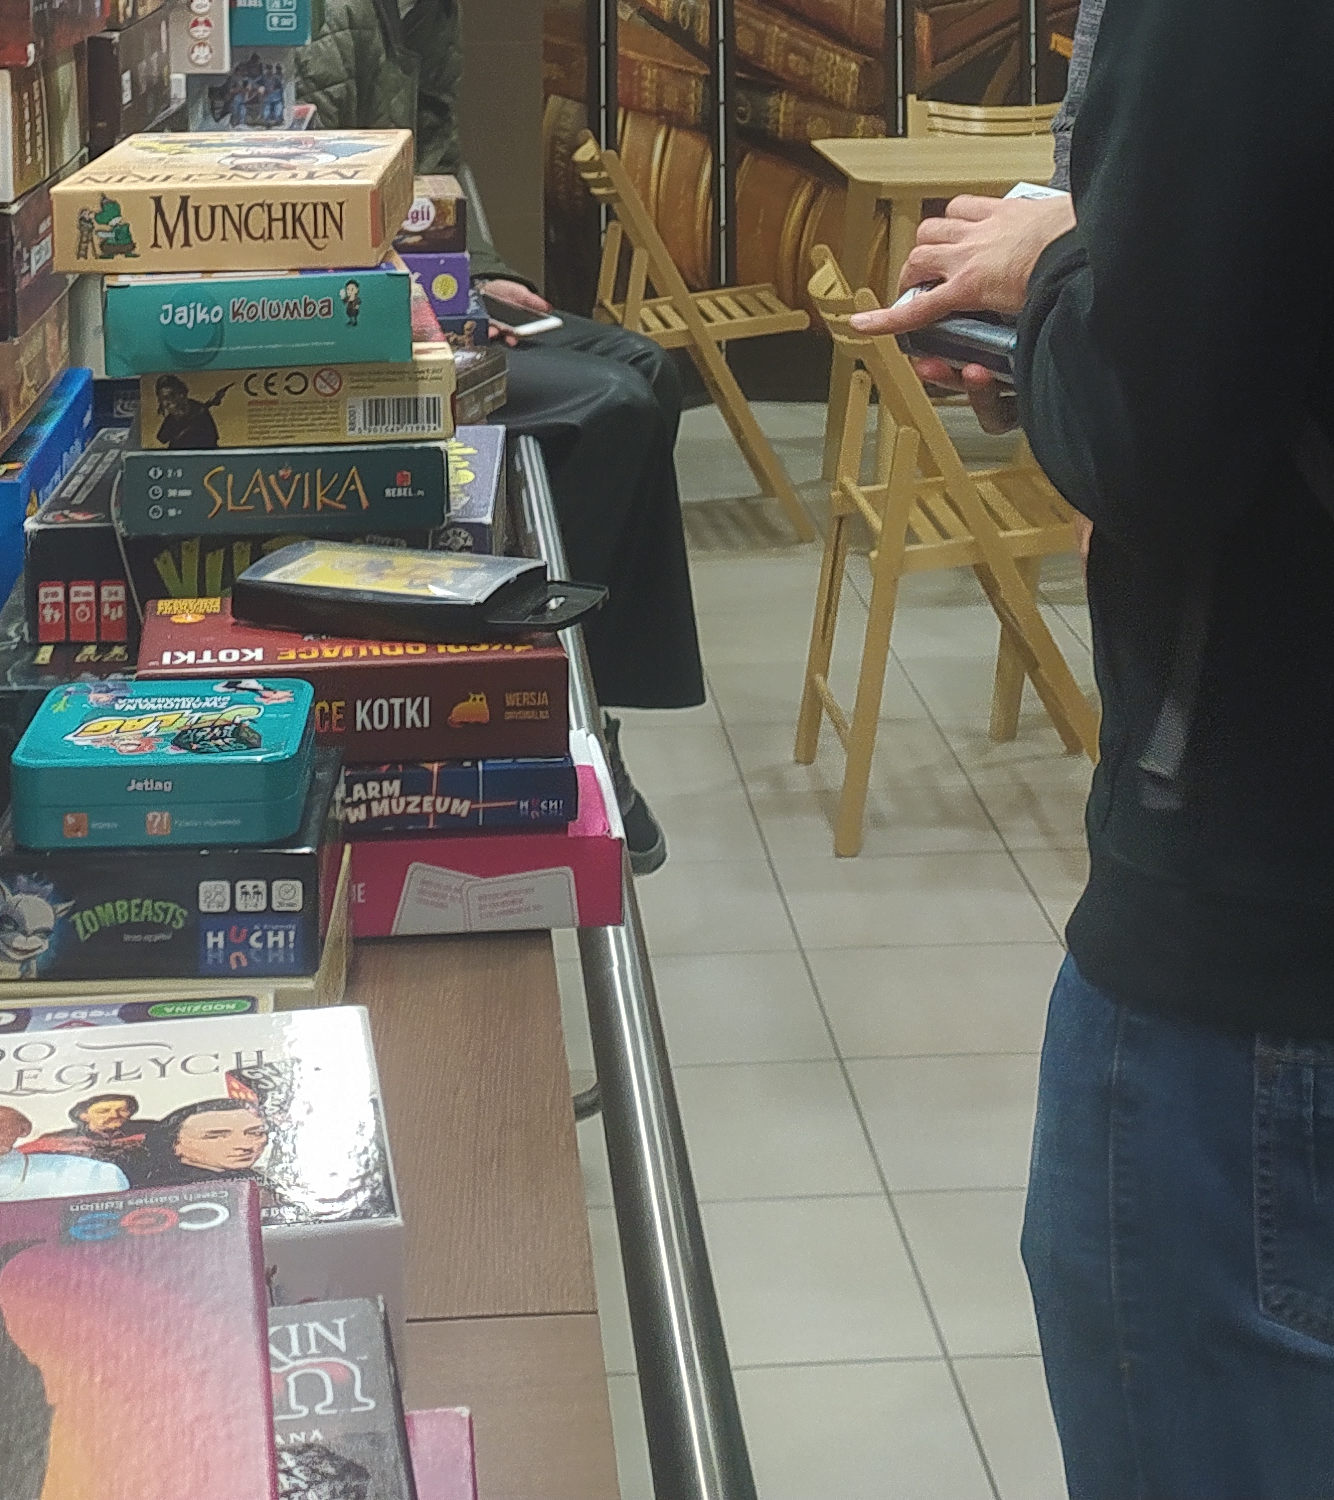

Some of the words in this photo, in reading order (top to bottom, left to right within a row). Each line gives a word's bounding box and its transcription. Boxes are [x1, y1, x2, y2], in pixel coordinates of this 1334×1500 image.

[149, 193, 347, 251] MUNCHKIN
[159, 302, 224, 330] Jajko
[229, 295, 334, 324] Kolumba
[202, 464, 370, 519] SLAVIKA
[160, 647, 265, 665] KOTKI
[354, 695, 431, 733] KOTKI
[504, 691, 550, 708] WERSJA
[126, 778, 174, 793] Jetlag
[369, 794, 472, 819] MUZEUM
[69, 898, 189, 944] ZOMBEASTS
[205, 924, 296, 951] HUCH!
